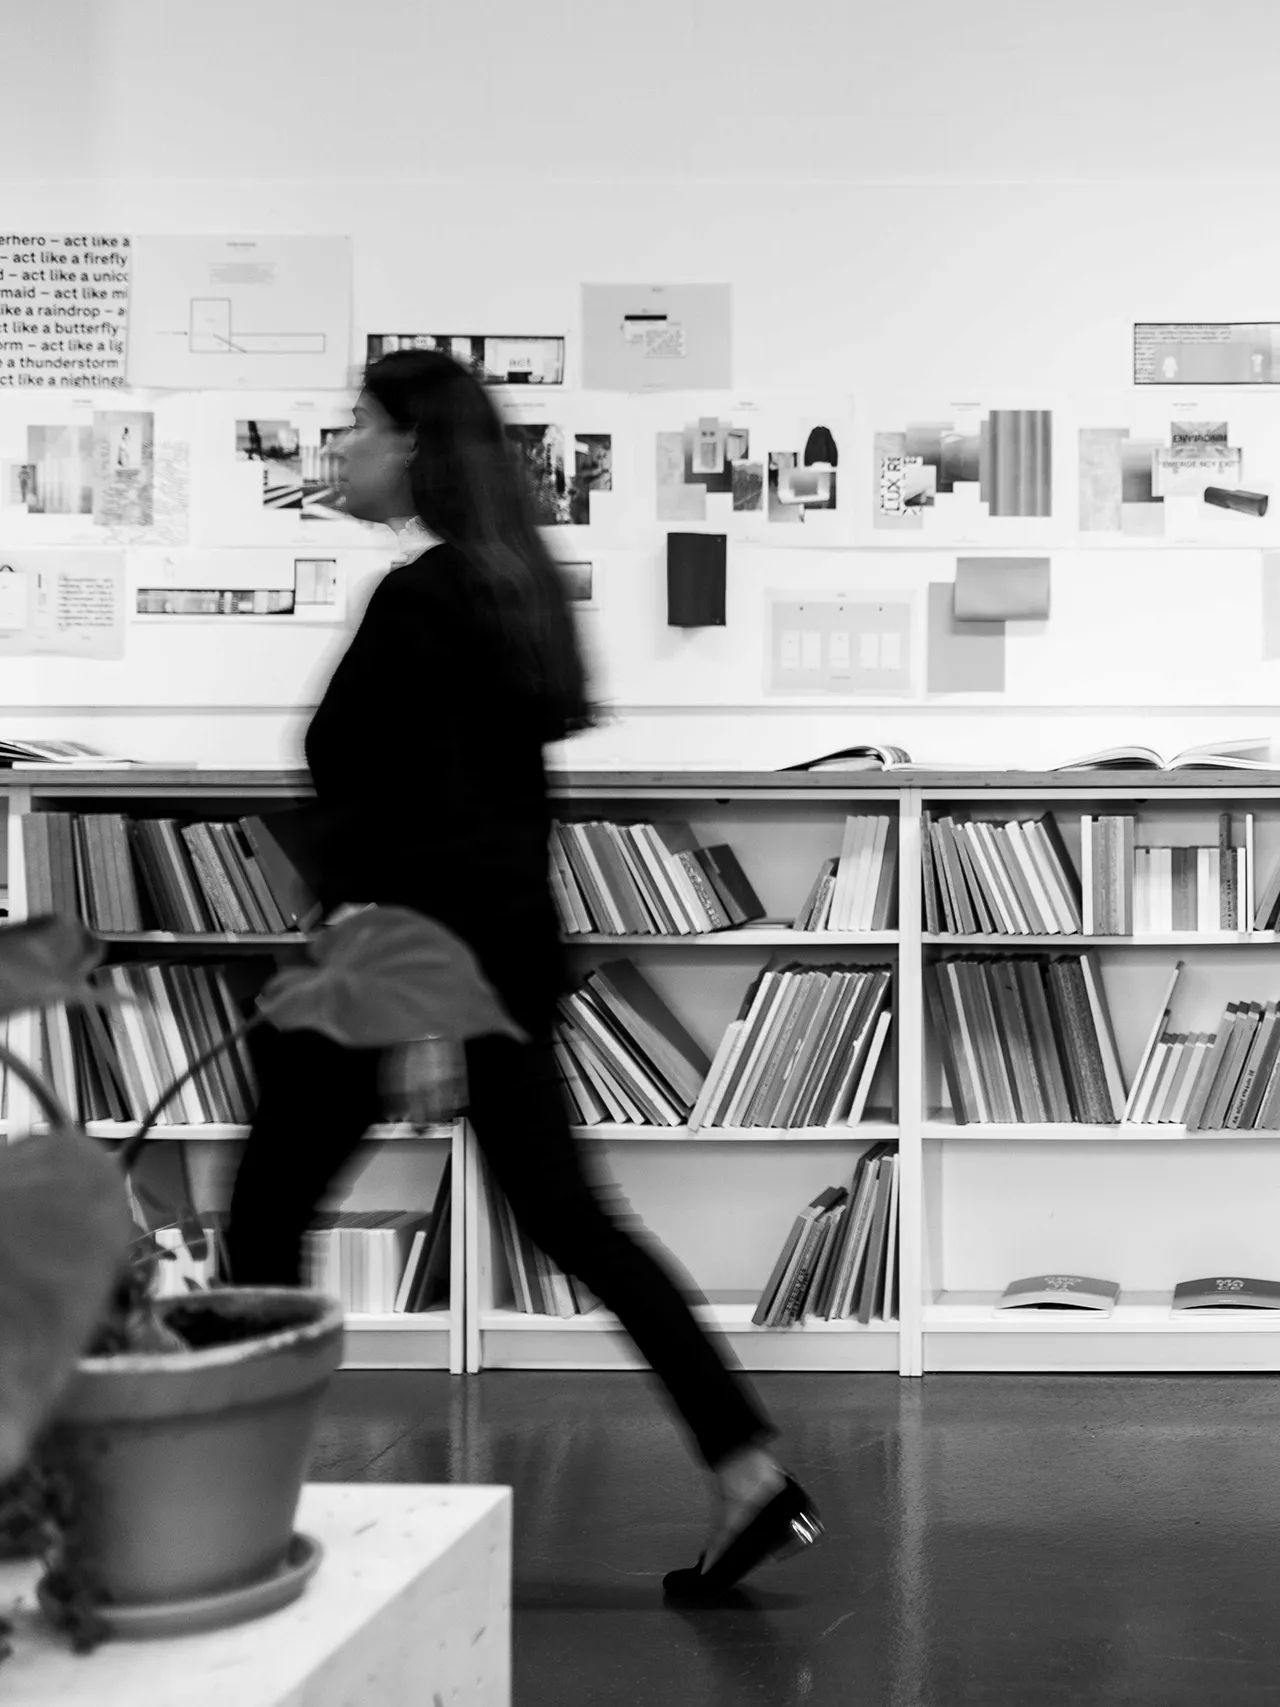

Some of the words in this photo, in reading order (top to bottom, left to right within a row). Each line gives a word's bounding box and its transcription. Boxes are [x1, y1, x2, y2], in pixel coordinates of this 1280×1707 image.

[64, 236, 87, 247] act
[92, 236, 118, 247] like
[122, 239, 130, 247] a
[13, 252, 36, 263] act
[40, 252, 67, 264] like
[72, 255, 79, 264] a
[84, 252, 127, 267] firefly
[22, 270, 45, 281] act
[50, 269, 76, 281] like
[81, 273, 88, 282] a
[55, 288, 78, 299] act
[83, 287, 108, 299] like
[26, 308, 33, 316] a
[38, 305, 100, 319] raindrop
[13, 322, 38, 334] like
[43, 325, 50, 334] a
[55, 322, 119, 336] butterfly
[42, 341, 64, 351] act
[68, 339, 93, 351] like
[98, 343, 105, 351] a
[7, 360, 15, 368] a
[20, 357, 118, 369] thunderstorm
[18, 374, 44, 386] like
[48, 377, 55, 386] a
